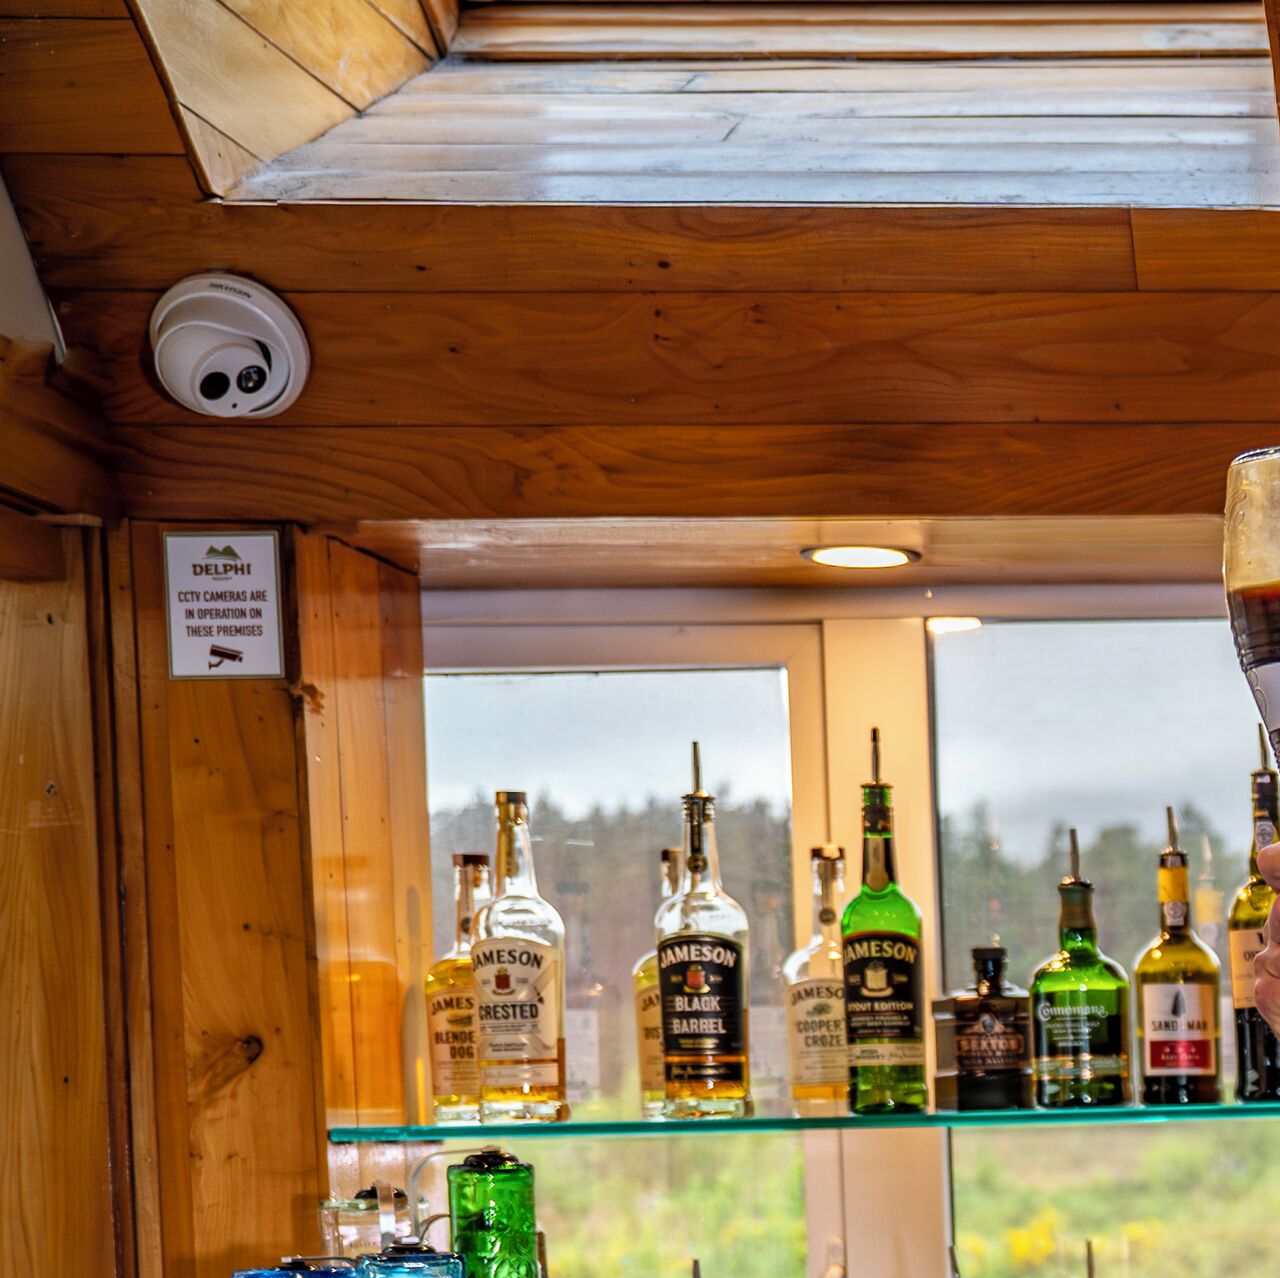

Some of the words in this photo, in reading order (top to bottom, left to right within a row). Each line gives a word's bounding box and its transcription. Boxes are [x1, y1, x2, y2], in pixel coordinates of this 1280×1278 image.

[192, 563, 251, 576] DELPHI
[178, 590, 200, 602] CCTV
[203, 590, 247, 602] CAMERAS
[250, 590, 268, 601] ARE
[185, 608, 194, 620] IN
[197, 608, 247, 620] OPERATION
[250, 608, 262, 619] ON
[186, 625, 214, 637] THESE
[216, 625, 263, 637] PREMISES
[472, 949, 543, 971] JAMESON
[660, 944, 737, 968] JAMESON
[675, 995, 721, 1012] BLACK
[792, 987, 845, 1006] JAMESO
[431, 996, 474, 1016] JAMES
[479, 1003, 539, 1021] CRESTED
[672, 1018, 727, 1034] BARREL
[796, 1018, 846, 1033] COOPER'
[435, 1031, 476, 1045] BLENDE
[804, 1034, 843, 1047] CROZE
[450, 1046, 474, 1059] DOG
